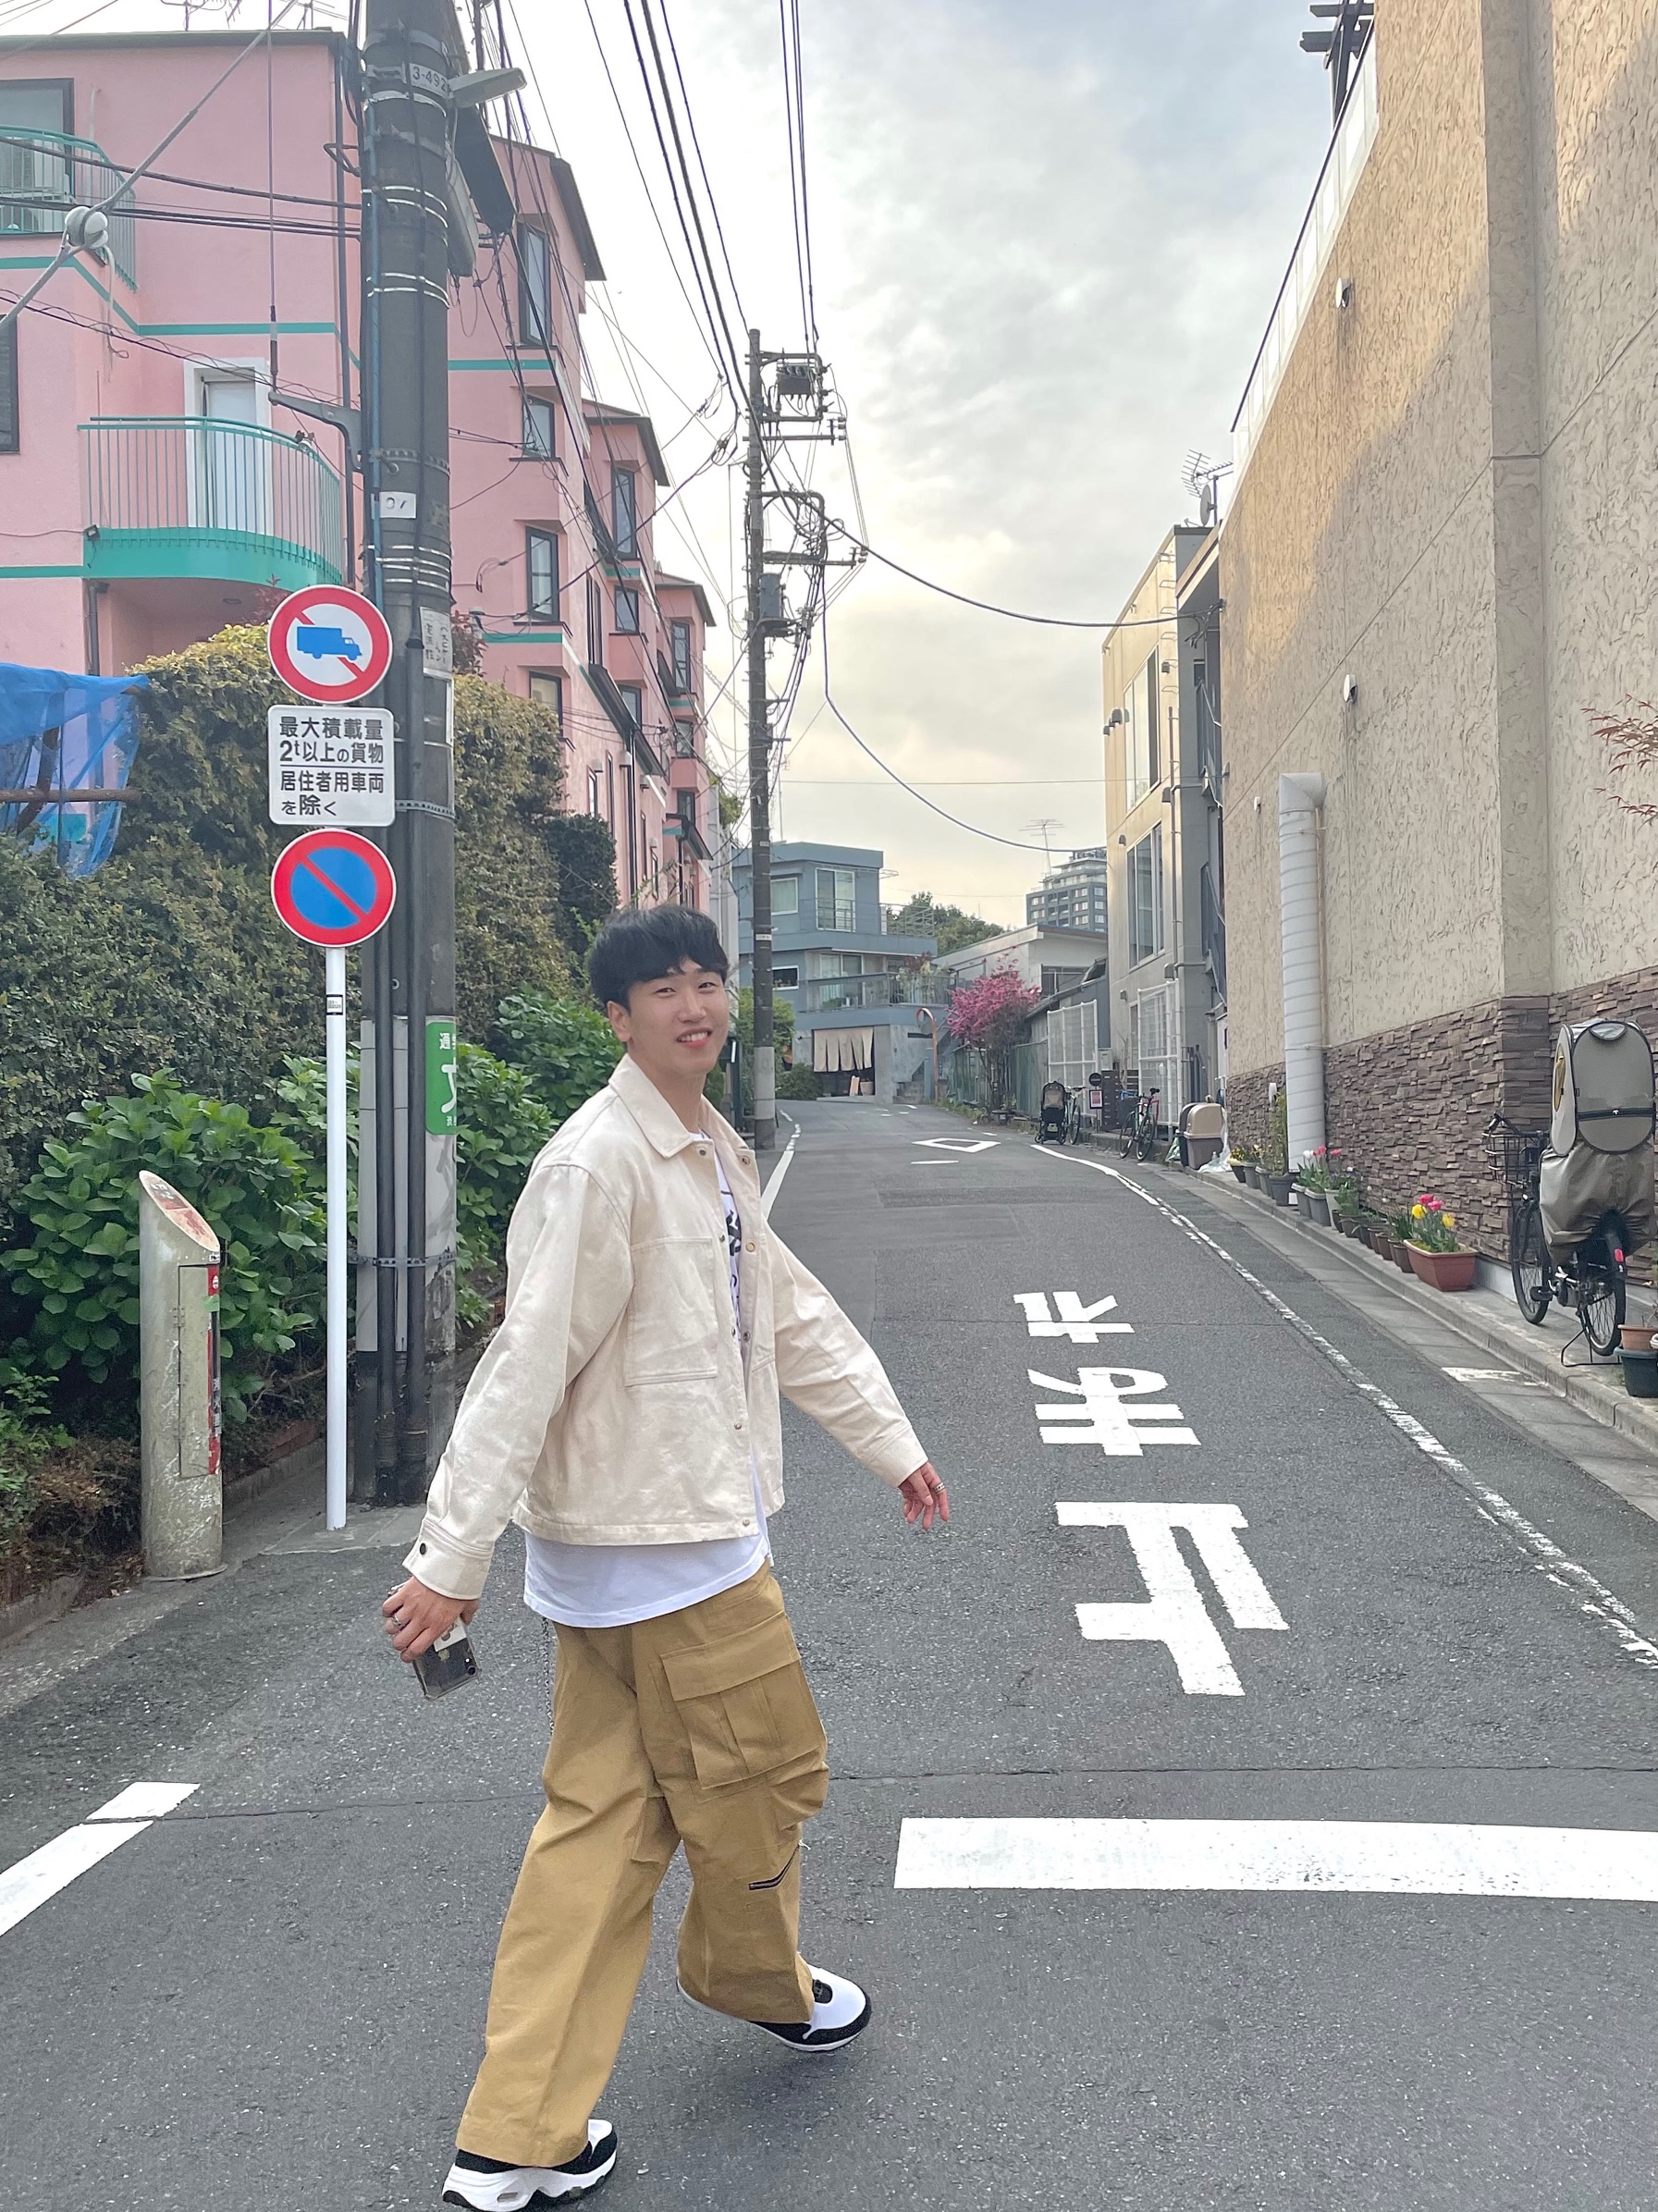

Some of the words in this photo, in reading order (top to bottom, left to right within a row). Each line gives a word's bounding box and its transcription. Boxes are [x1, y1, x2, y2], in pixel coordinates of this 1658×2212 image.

[279, 716, 383, 740] 最大積載量
[279, 740, 384, 764] 2t以上の貨物
[280, 770, 384, 793] 居住者用車両
[281, 794, 337, 816] を除く
[1013, 1291, 1290, 1696] 止まれ
